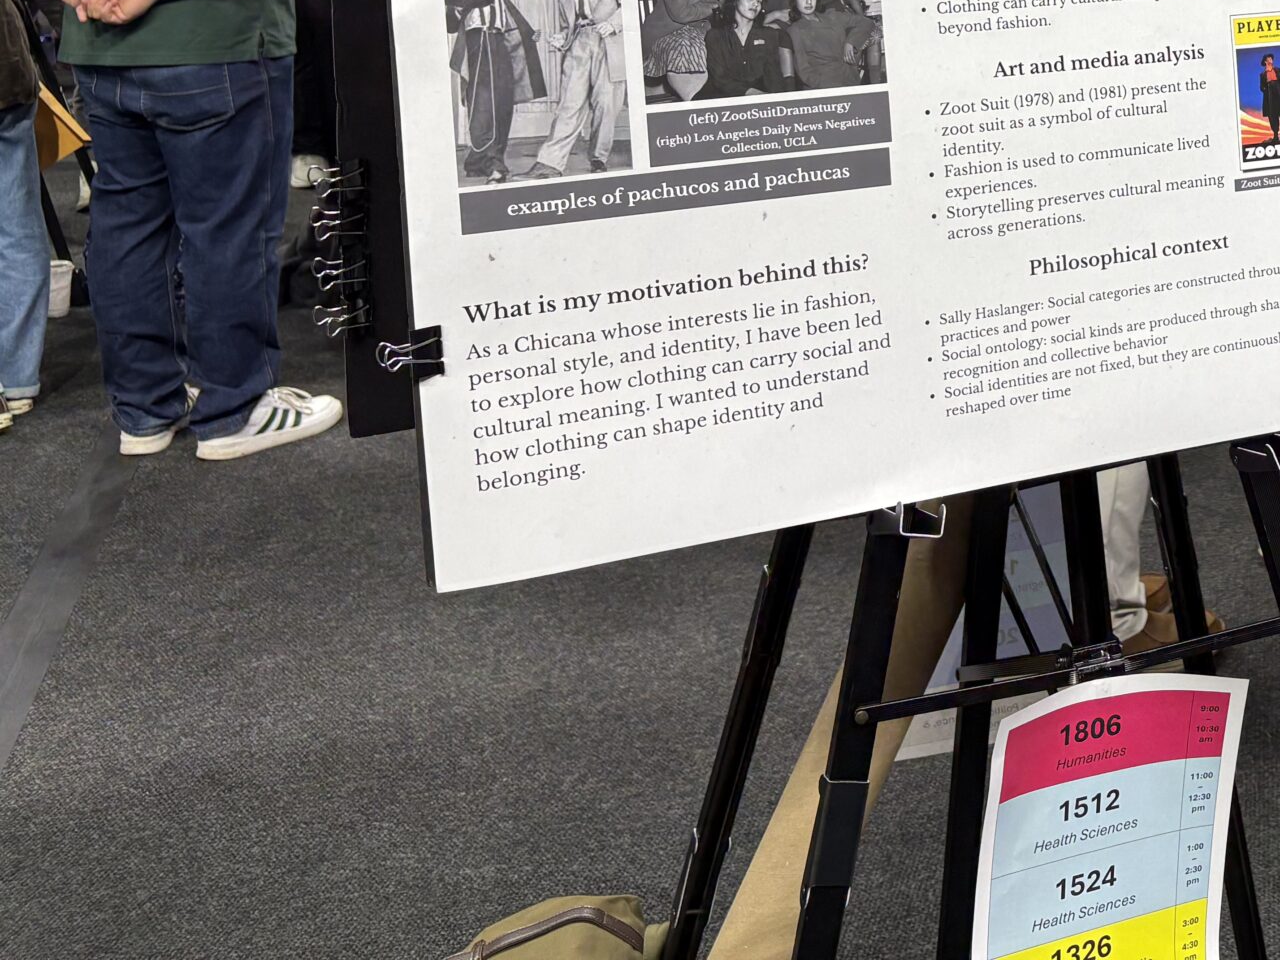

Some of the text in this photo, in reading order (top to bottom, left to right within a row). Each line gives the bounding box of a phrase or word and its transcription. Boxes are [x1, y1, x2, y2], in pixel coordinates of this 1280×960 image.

[993, 43, 1204, 77] Art and media analysis
[688, 102, 851, 126] (left) ZootSuitDramaturgy
[721, 135, 817, 153] Collection, UCLA
[507, 167, 850, 215] examples of pachucos and pachucas
[1240, 180, 1261, 189] Zoot
[1263, 176, 1280, 186] Suit
[1029, 235, 1228, 276] Philosophical context
[1060, 714, 1121, 745] 1806
[1056, 746, 1126, 771] Humanities
[1190, 771, 1213, 780] 11:00
[1059, 788, 1119, 821] 1512
[1188, 792, 1211, 802] 12:30
[1191, 805, 1205, 814] pm
[1033, 818, 1138, 854] Health Sciences
[1187, 842, 1204, 852] 1:00
[1184, 864, 1202, 874] 2:30
[1055, 864, 1116, 900] 1524
[1186, 877, 1199, 887] pm
[1031, 894, 1136, 932] Health Sciences
[1182, 916, 1199, 927] 3:00
[1181, 939, 1198, 950] 4:30
